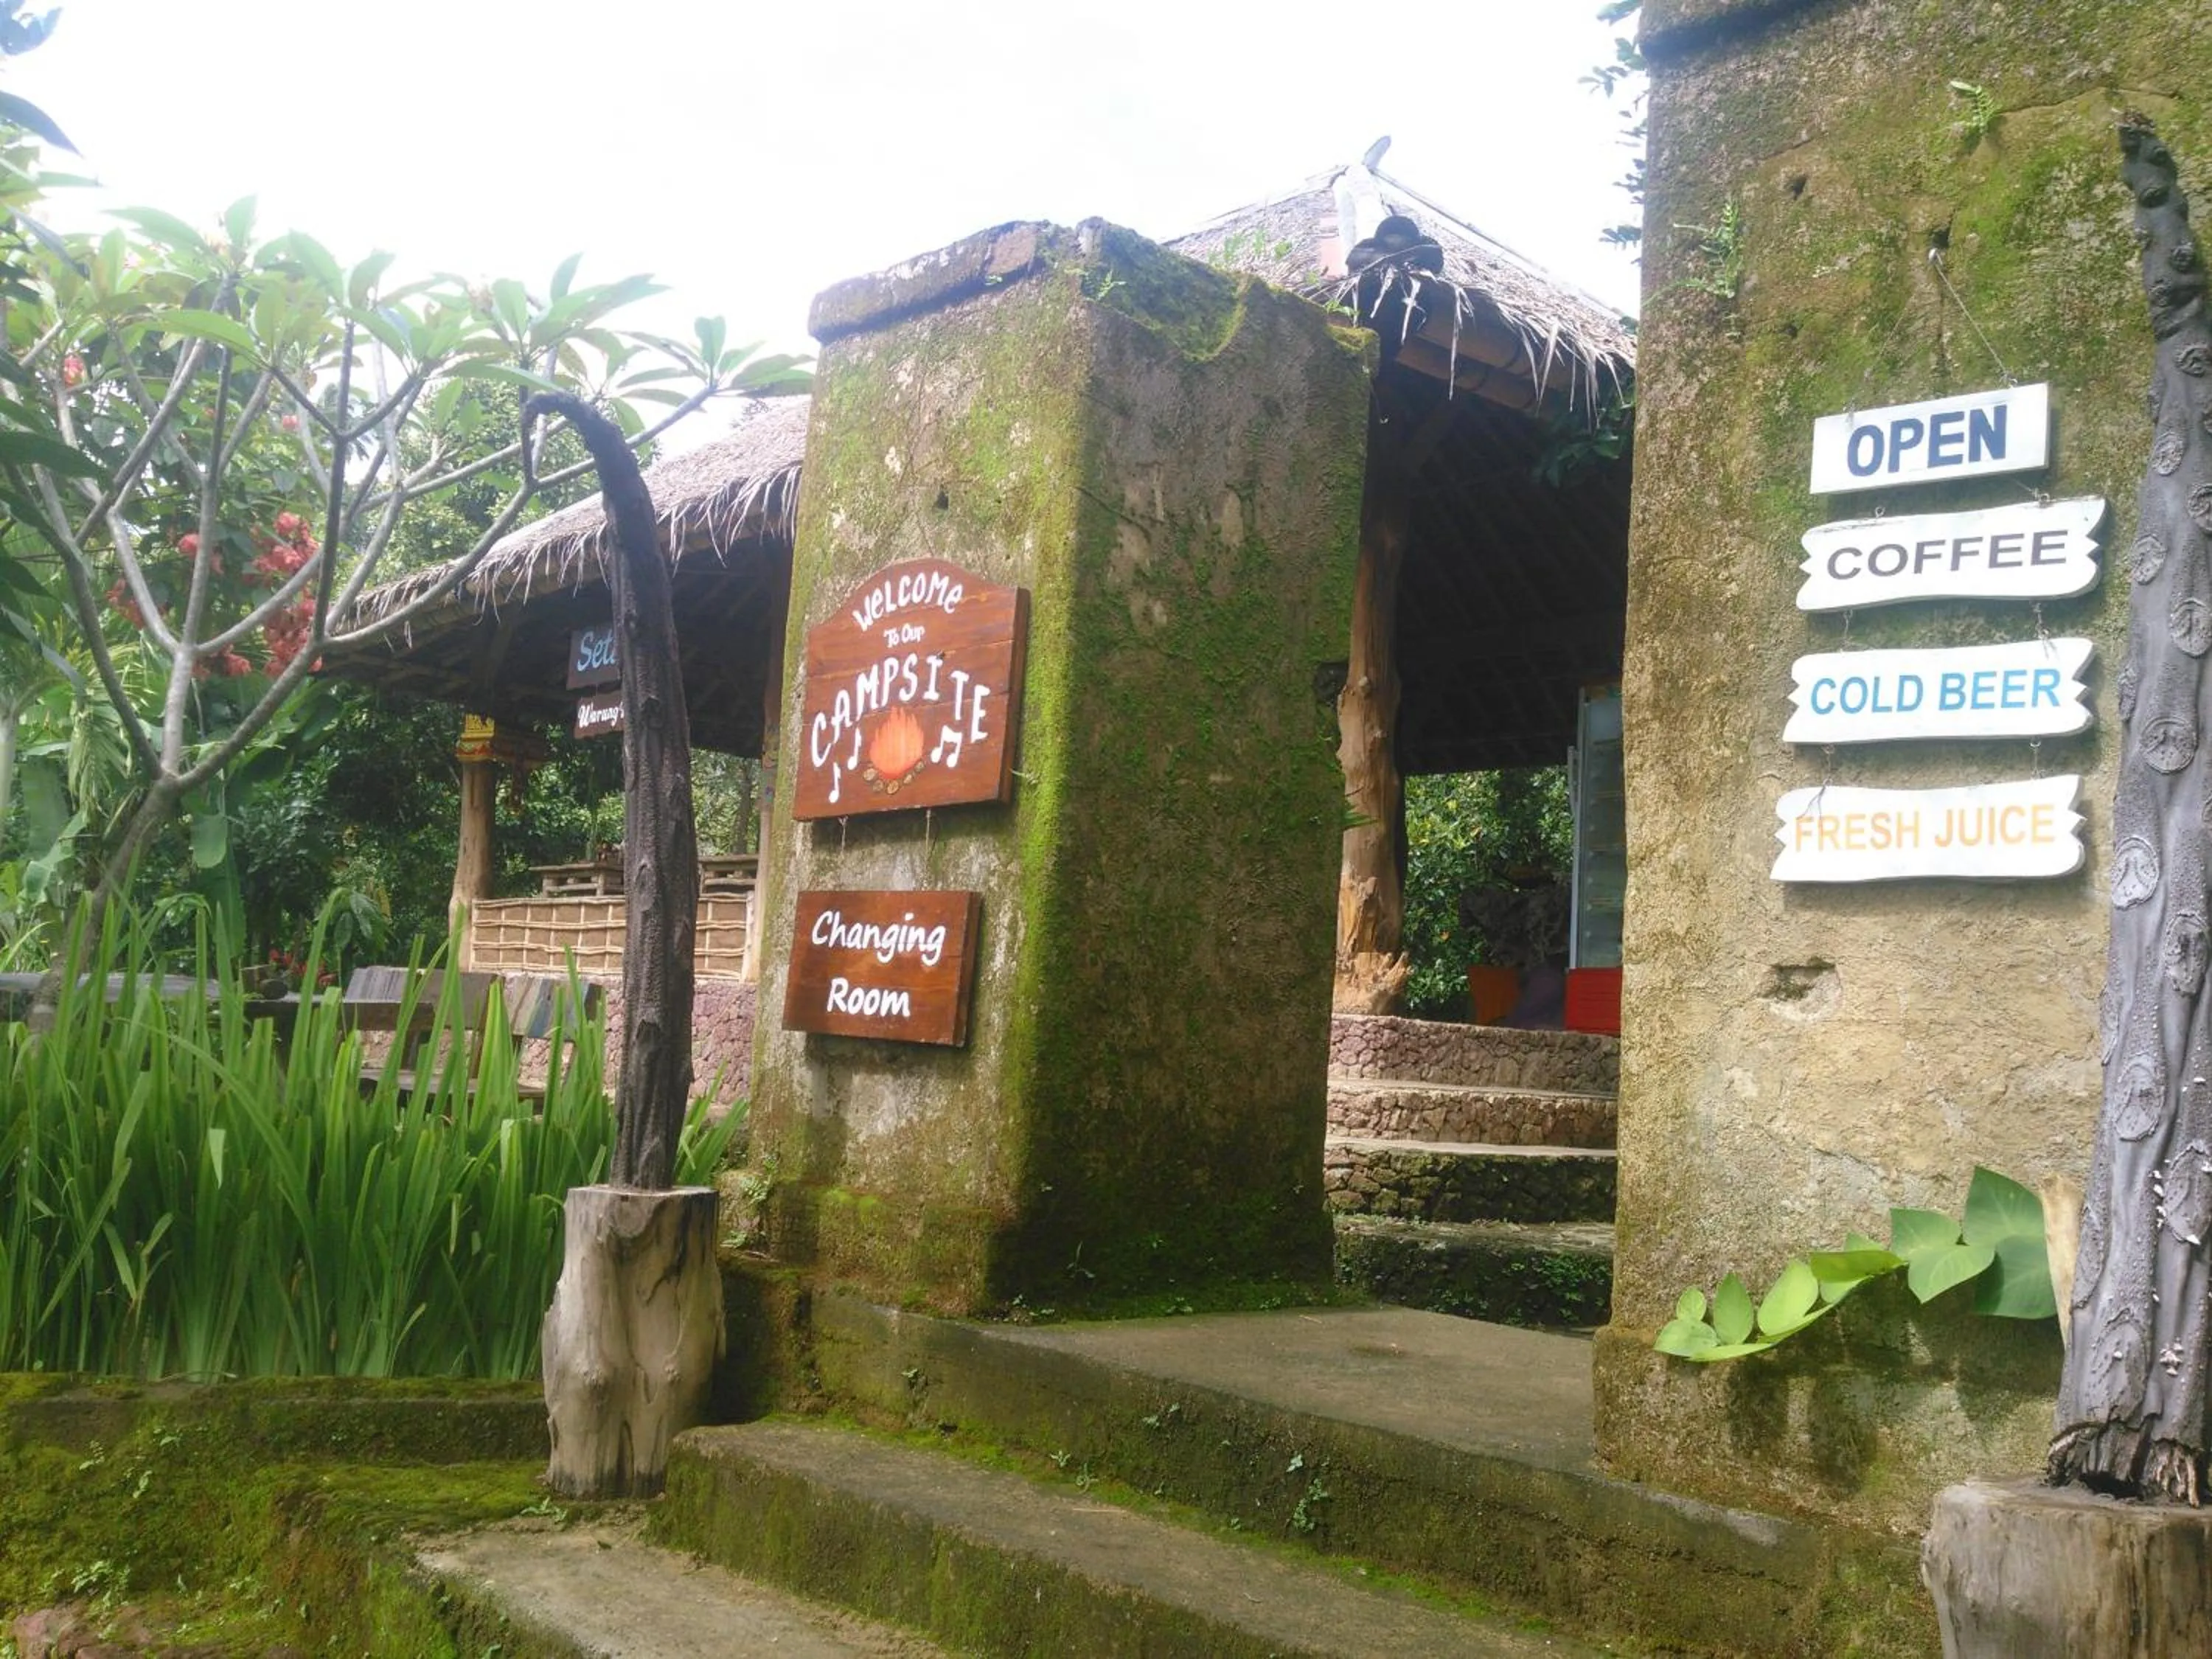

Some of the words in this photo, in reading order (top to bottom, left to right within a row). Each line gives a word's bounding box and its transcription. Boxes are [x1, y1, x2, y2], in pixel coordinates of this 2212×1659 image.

[1846, 404, 2008, 477] OPEN
[1826, 529, 2069, 580] COFFEE
[883, 627, 900, 648] To
[811, 653, 991, 768] CAMPSITE
[1810, 675, 1924, 715] COLD
[1938, 668, 2062, 711] BEER
[1795, 811, 1919, 852] FRESH
[1934, 804, 2056, 849] JUICE
[812, 911, 946, 966] Changing
[827, 977, 911, 1017] Room
